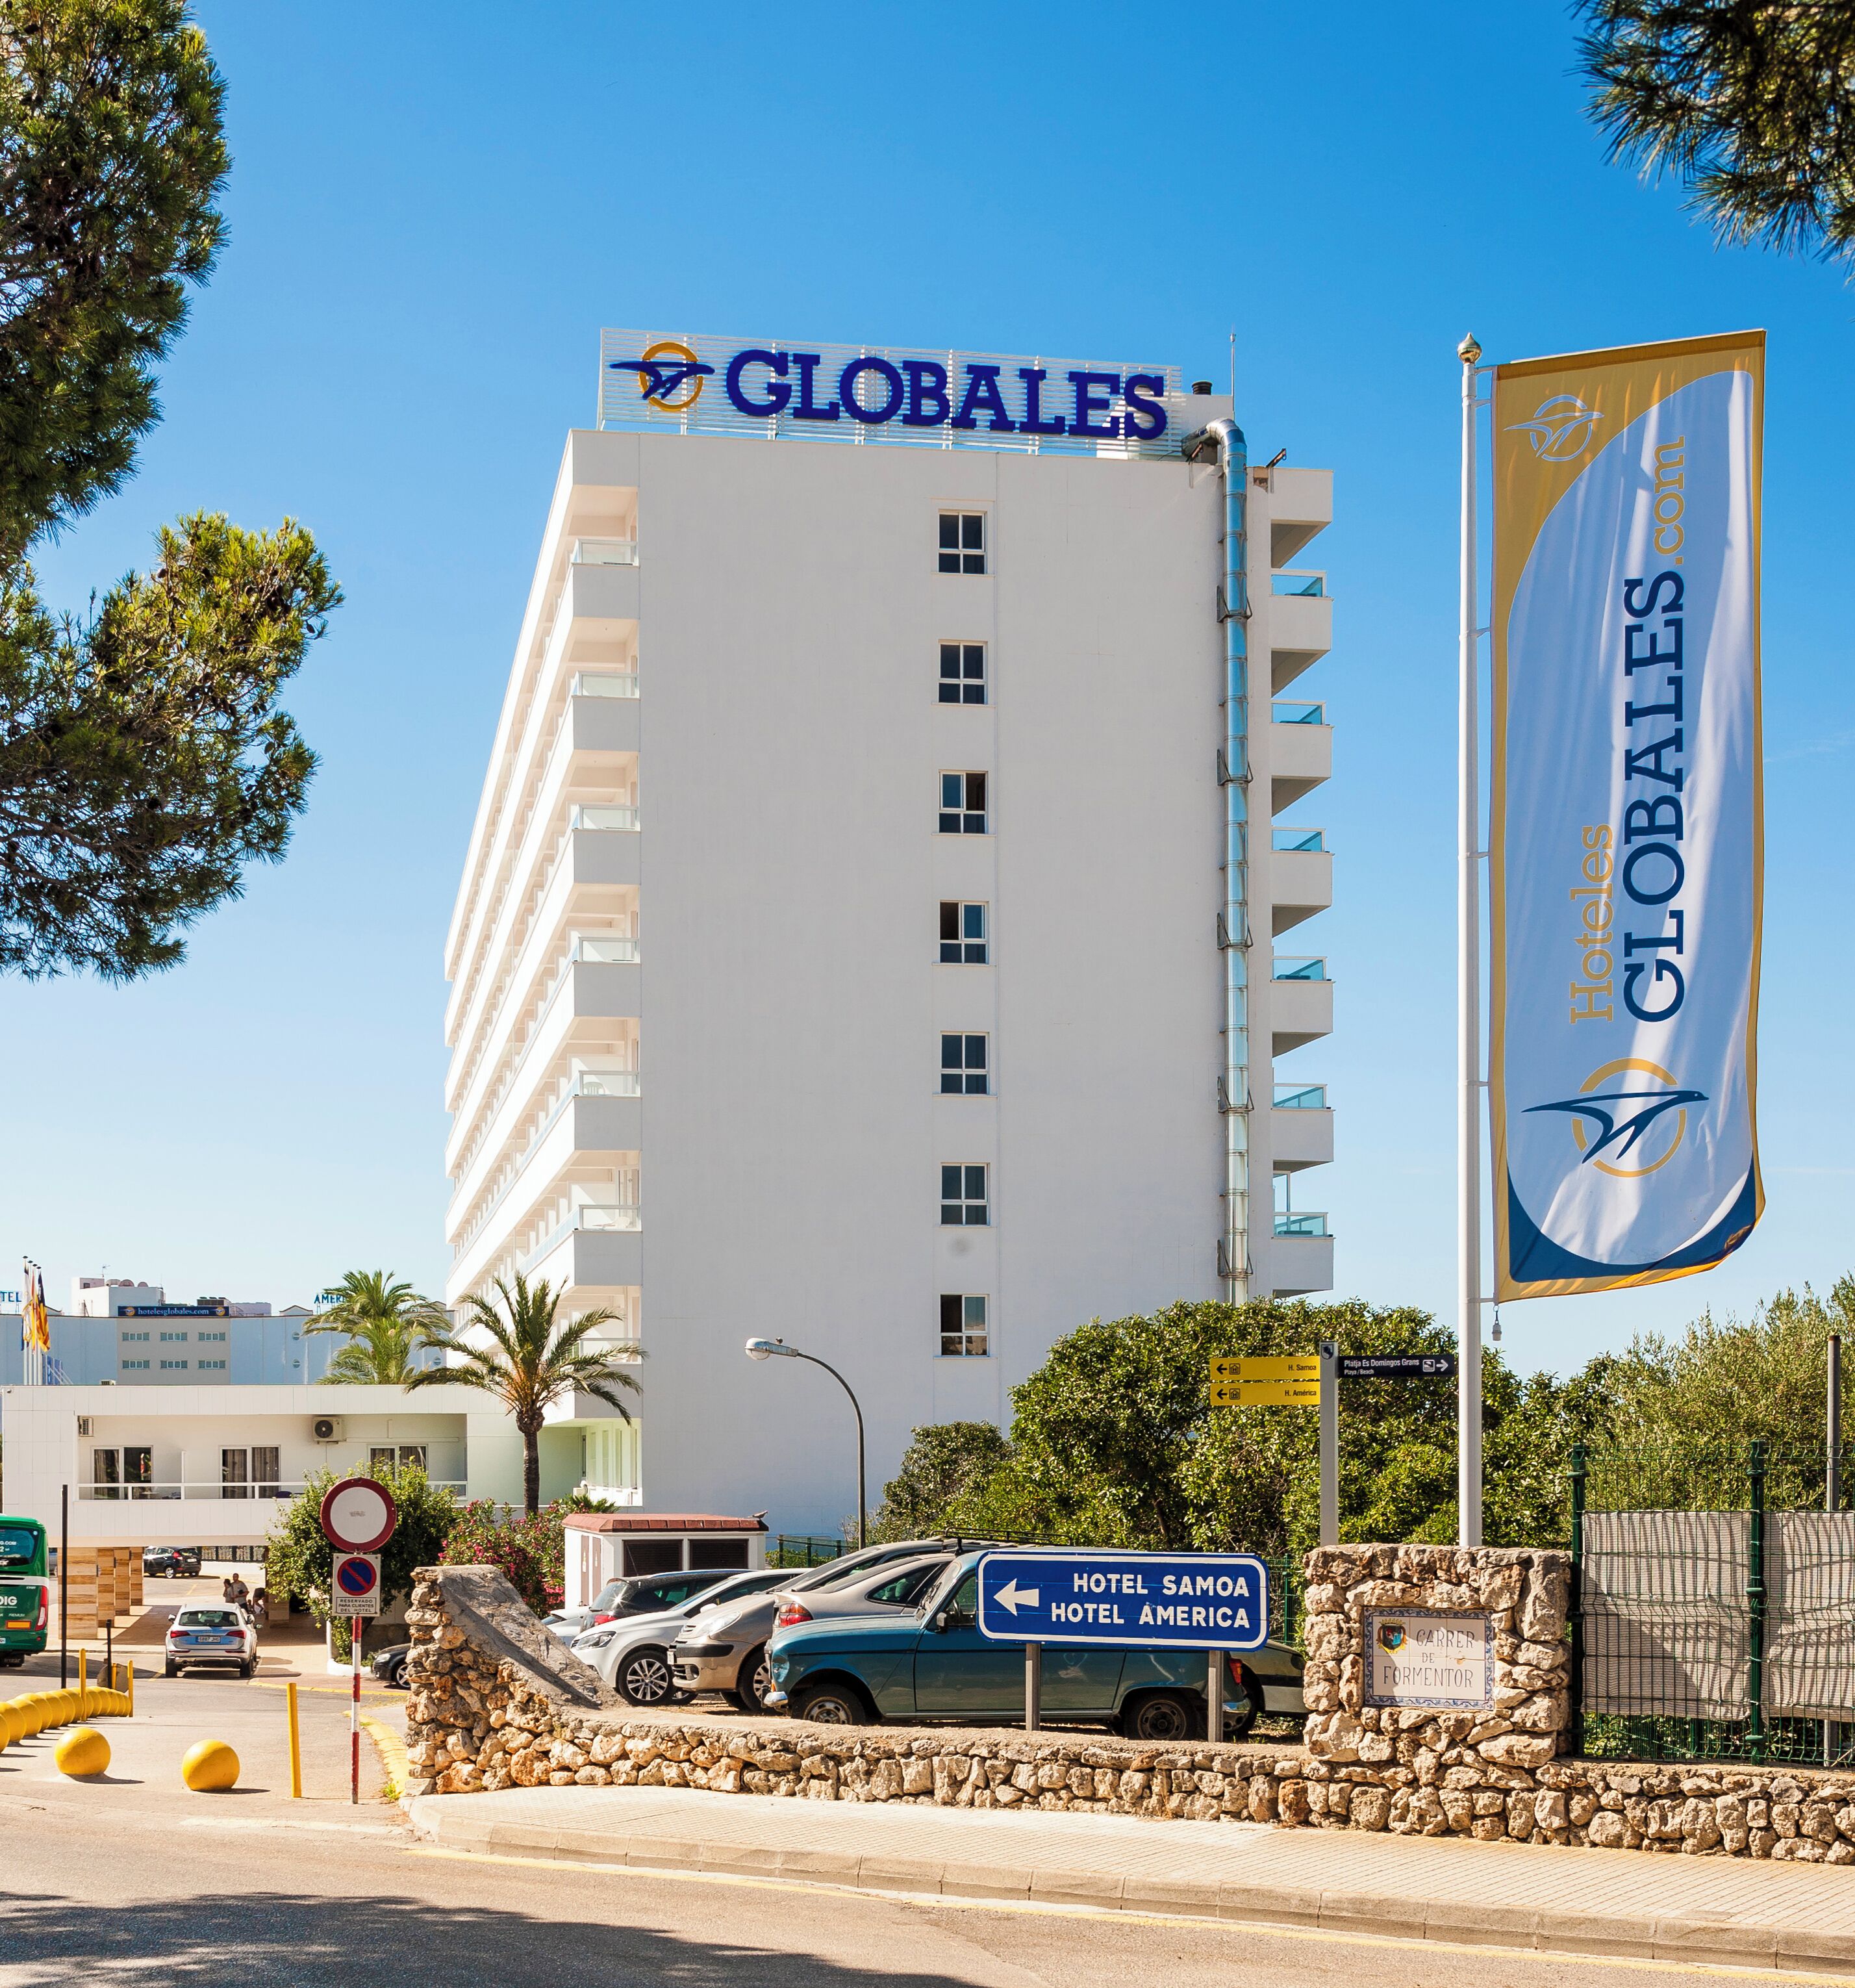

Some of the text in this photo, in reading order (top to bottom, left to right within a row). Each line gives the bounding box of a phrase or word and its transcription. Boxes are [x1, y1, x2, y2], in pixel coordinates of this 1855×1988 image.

[726, 349, 1167, 440] GLOBALES
[1622, 435, 1685, 1023] GLOBALES.com
[1569, 824, 1613, 1025] Hoteles
[138, 1307, 209, 1316] hotelesglobales.com
[1344, 1360, 1361, 1368] Platja
[1074, 1573, 1250, 1597] HOTEL SAMOA
[1052, 1603, 1250, 1628] HOTEL AMERICA
[1416, 1629, 1475, 1648] CARRER
[1422, 1652, 1435, 1664] DE
[1383, 1666, 1474, 1689] FORMENTOR
